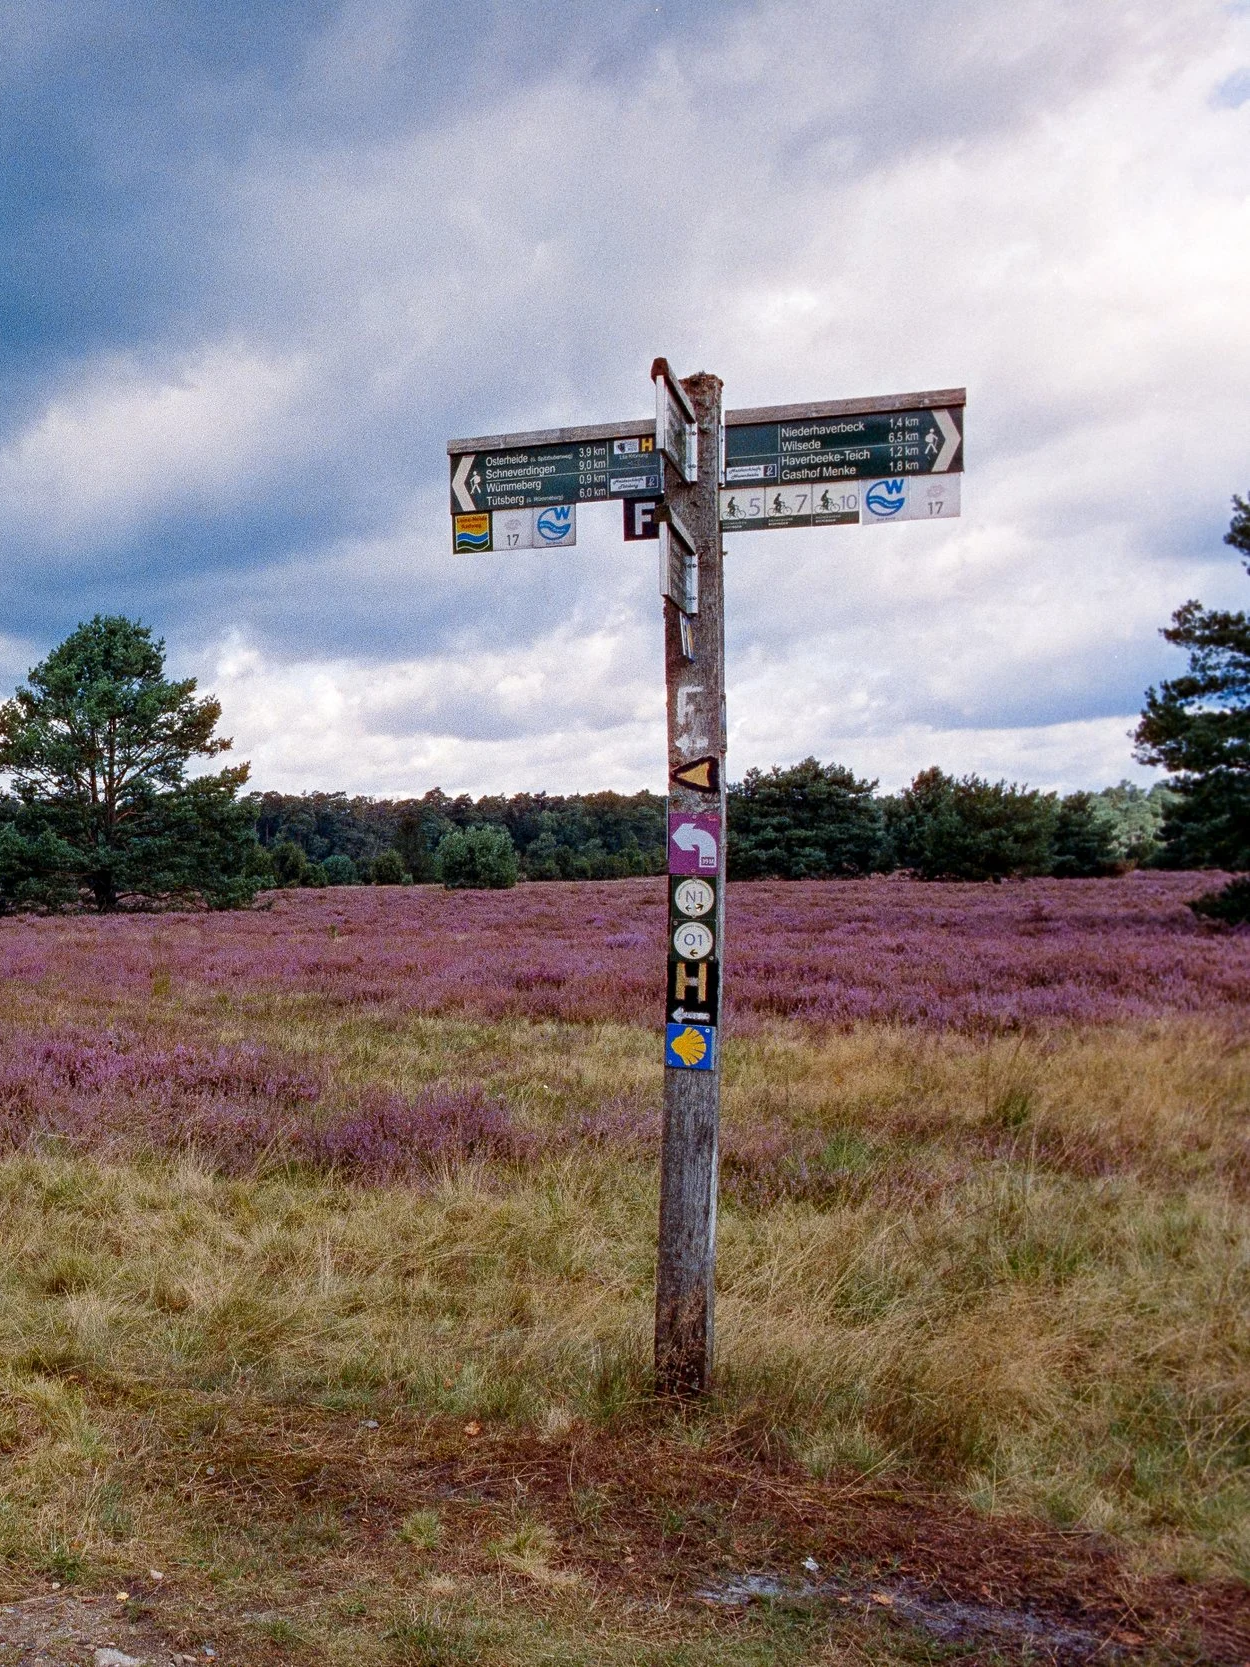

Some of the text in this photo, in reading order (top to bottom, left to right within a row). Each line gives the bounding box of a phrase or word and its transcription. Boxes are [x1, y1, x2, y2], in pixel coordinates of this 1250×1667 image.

[781, 418, 919, 437] Niederhaverbeck 1,4 km
[641, 438, 653, 452] H
[782, 432, 919, 452] Wilsede 6,5 km
[486, 454, 528, 466] Osterheide
[579, 447, 592, 458] 3,9
[594, 446, 605, 456] km
[781, 446, 919, 466] Haverbeeke-Teich 1,2 km
[486, 460, 606, 479] Schneverdingen 9,0 km
[782, 460, 919, 480] Gasthof Menke 1,8 km
[486, 472, 606, 493] Wümmeberg 0,9 km
[486, 495, 525, 506] Tütsberg
[579, 488, 592, 498] 6,0
[594, 487, 606, 497] km
[795, 494, 808, 513] 7
[840, 494, 857, 510] 10
[749, 498, 761, 516] 5
[928, 501, 943, 514] 17
[635, 502, 655, 535] F
[506, 534, 519, 546] 17
[686, 890, 703, 903] N1
[675, 962, 707, 1002] H
